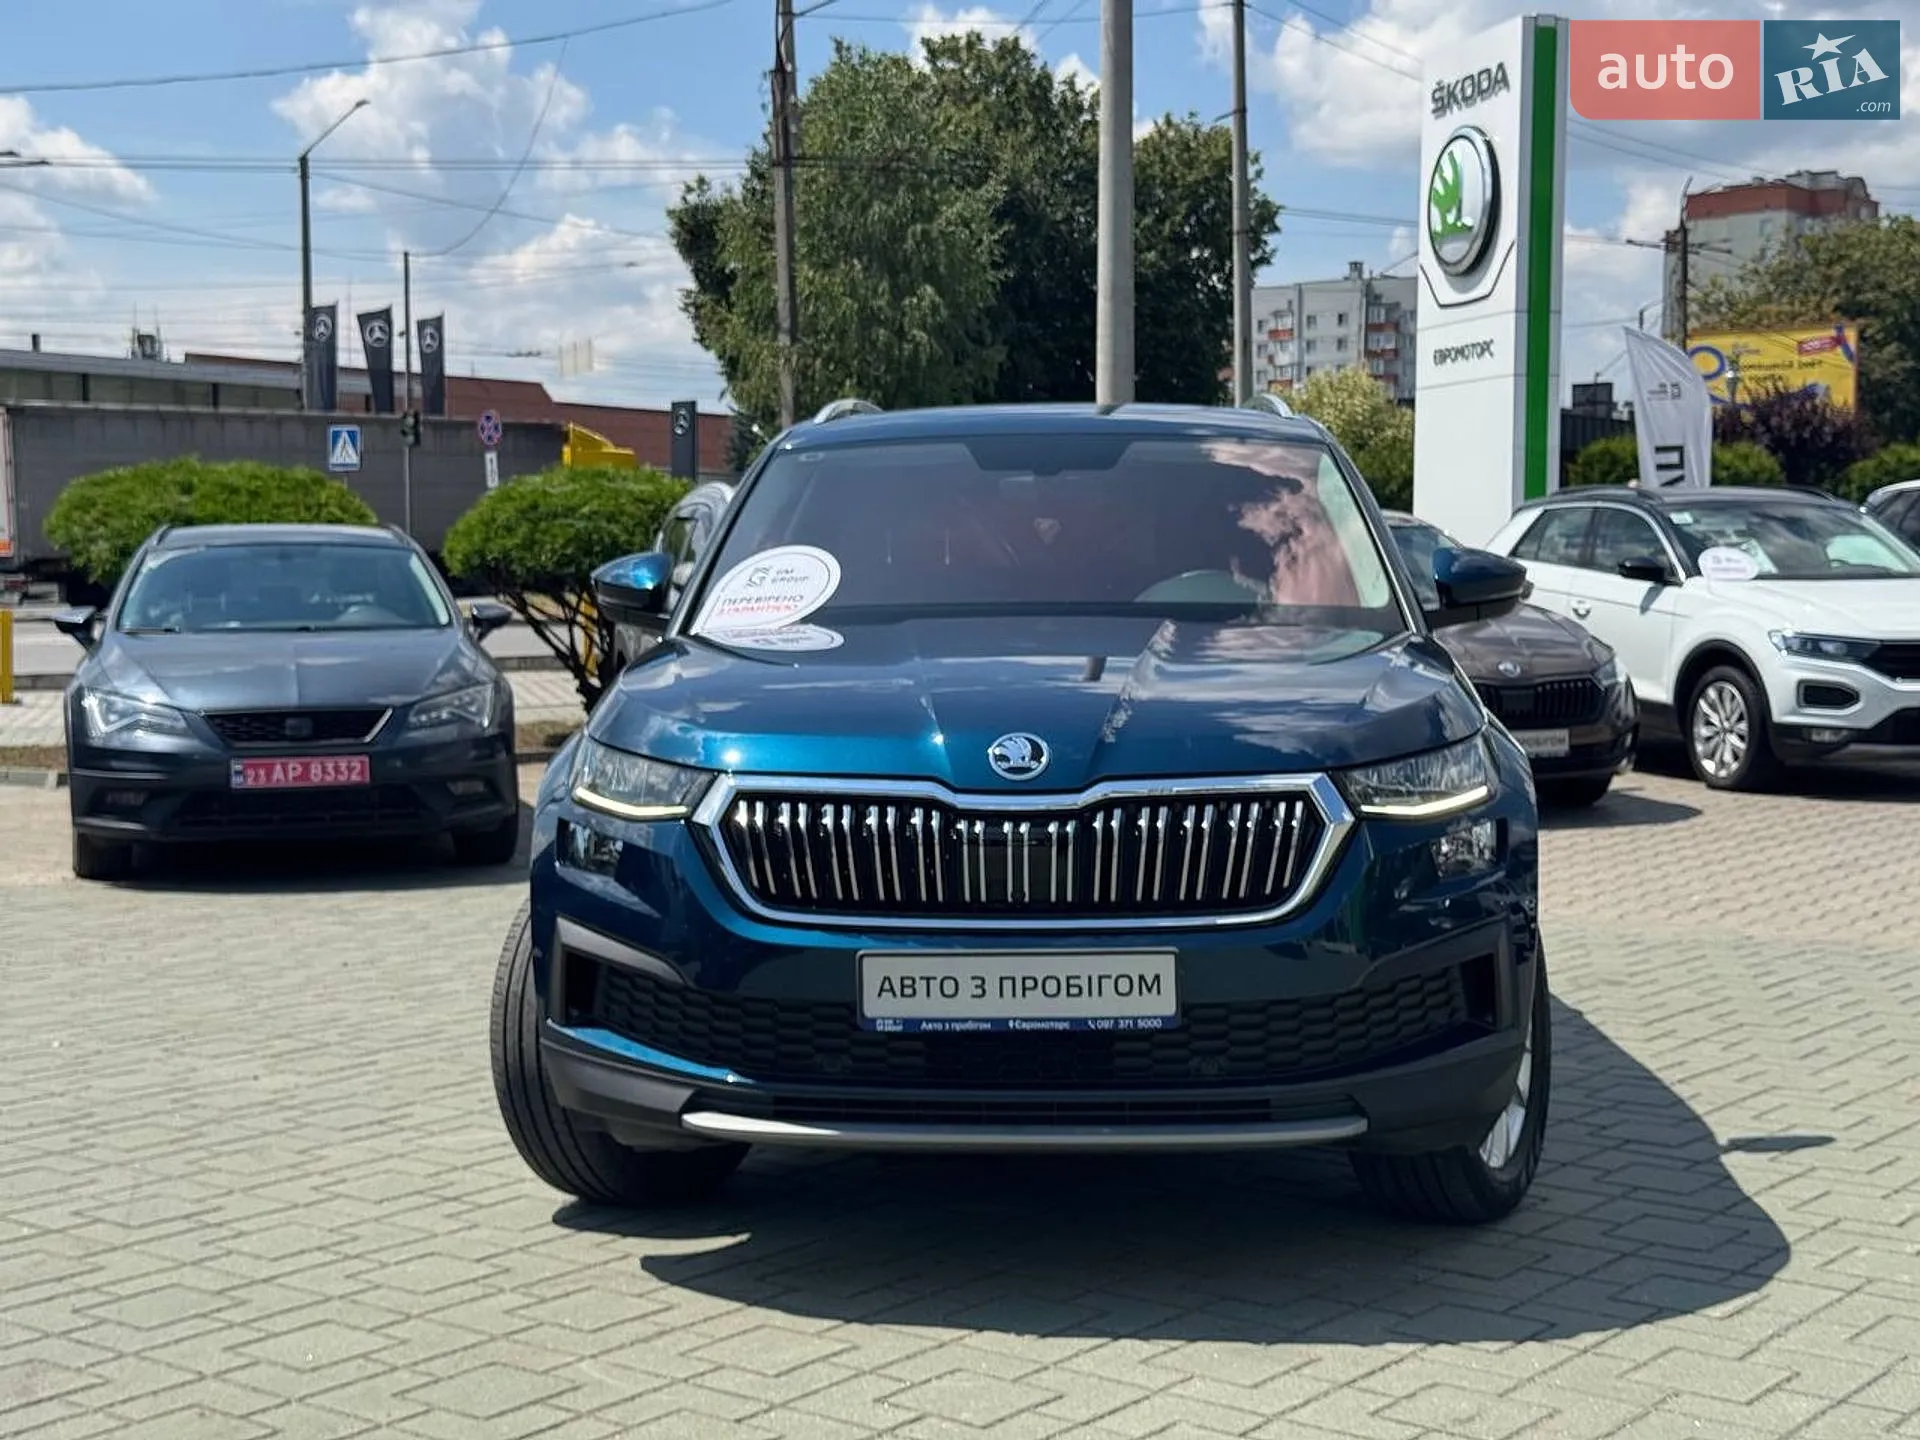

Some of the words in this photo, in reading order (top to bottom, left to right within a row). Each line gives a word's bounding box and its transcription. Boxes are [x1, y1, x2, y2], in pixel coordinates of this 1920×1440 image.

[1431, 61, 1511, 117] ŠKODA
[309, 760, 362, 782] 8332
[877, 975, 960, 999] АВТО
[970, 975, 987, 999] З
[999, 973, 1162, 998] ПРОБІГОМ
